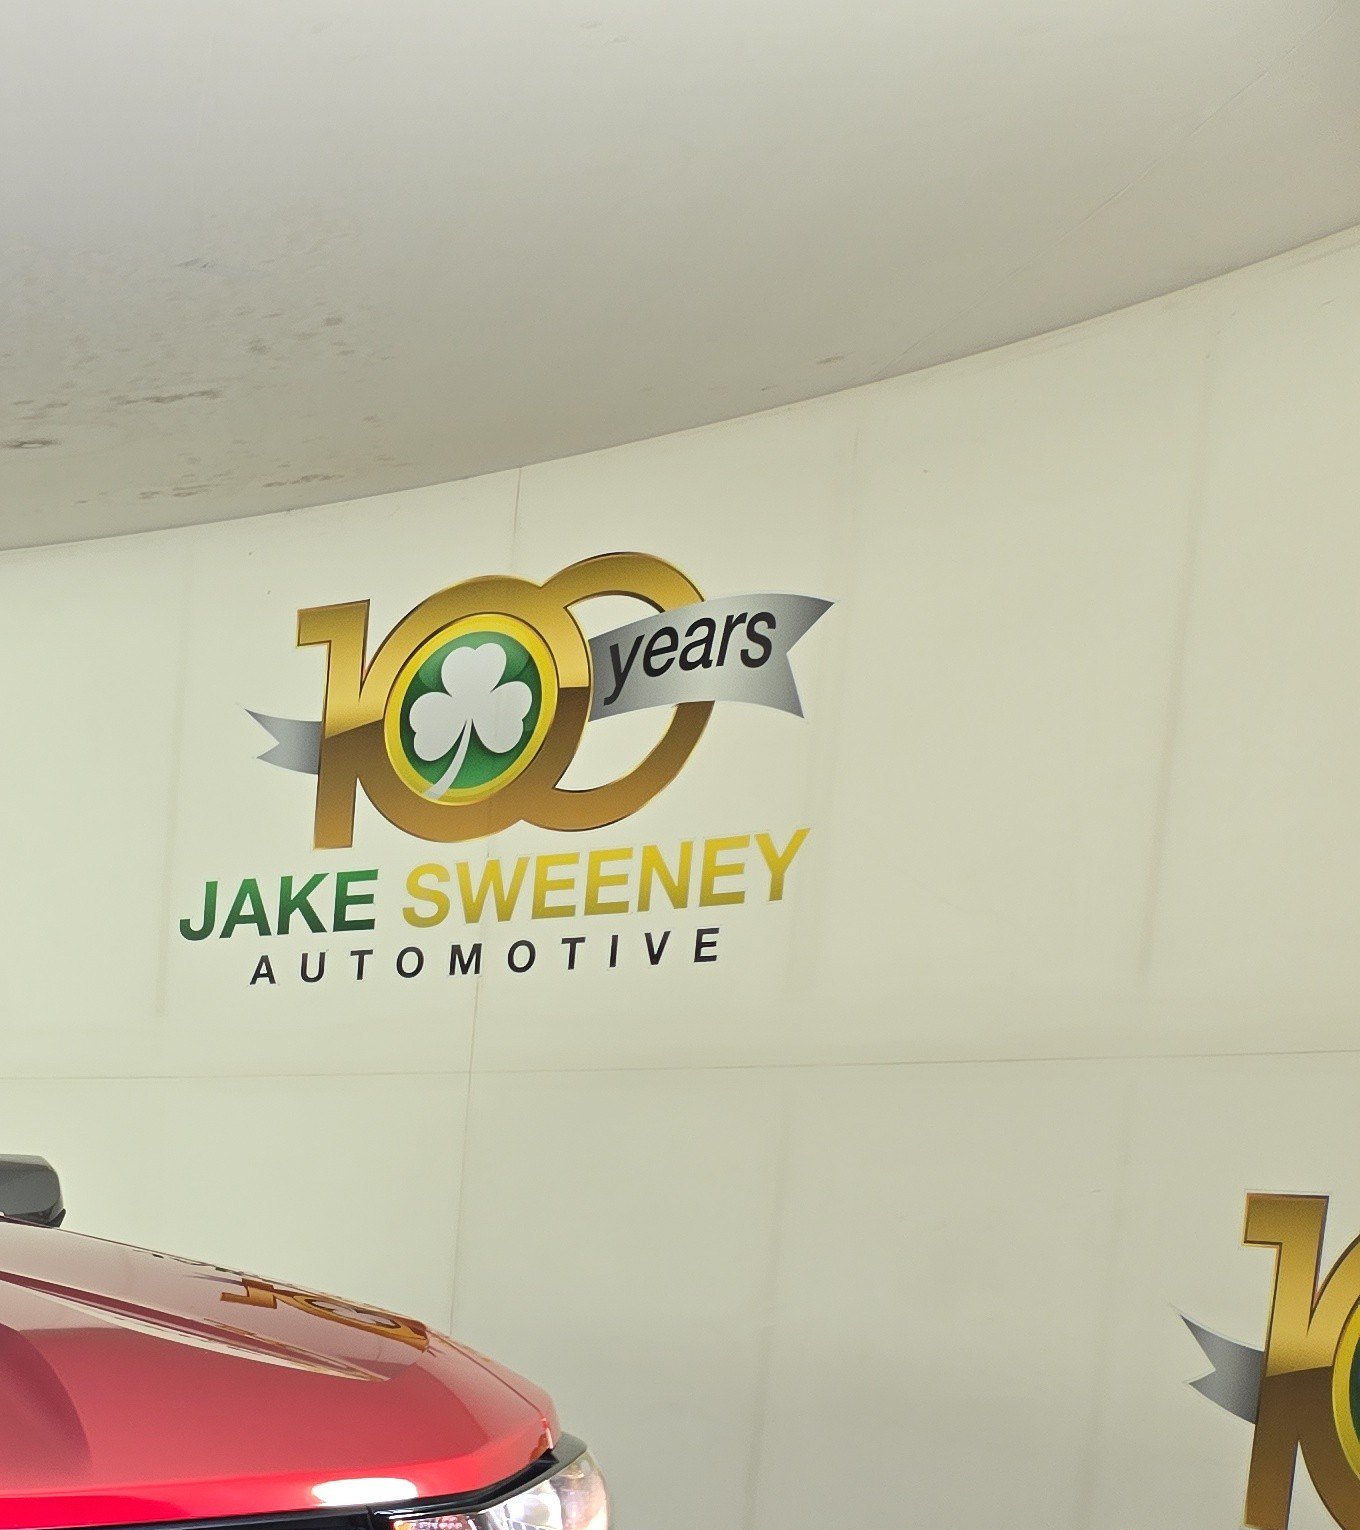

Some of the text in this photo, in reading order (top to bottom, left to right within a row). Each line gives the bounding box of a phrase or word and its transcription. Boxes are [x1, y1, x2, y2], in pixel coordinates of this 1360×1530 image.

[295, 551, 778, 850] 100 years
[179, 827, 811, 941] JAKE SWEENEY
[249, 927, 721, 986] AUTOMOTIVE
